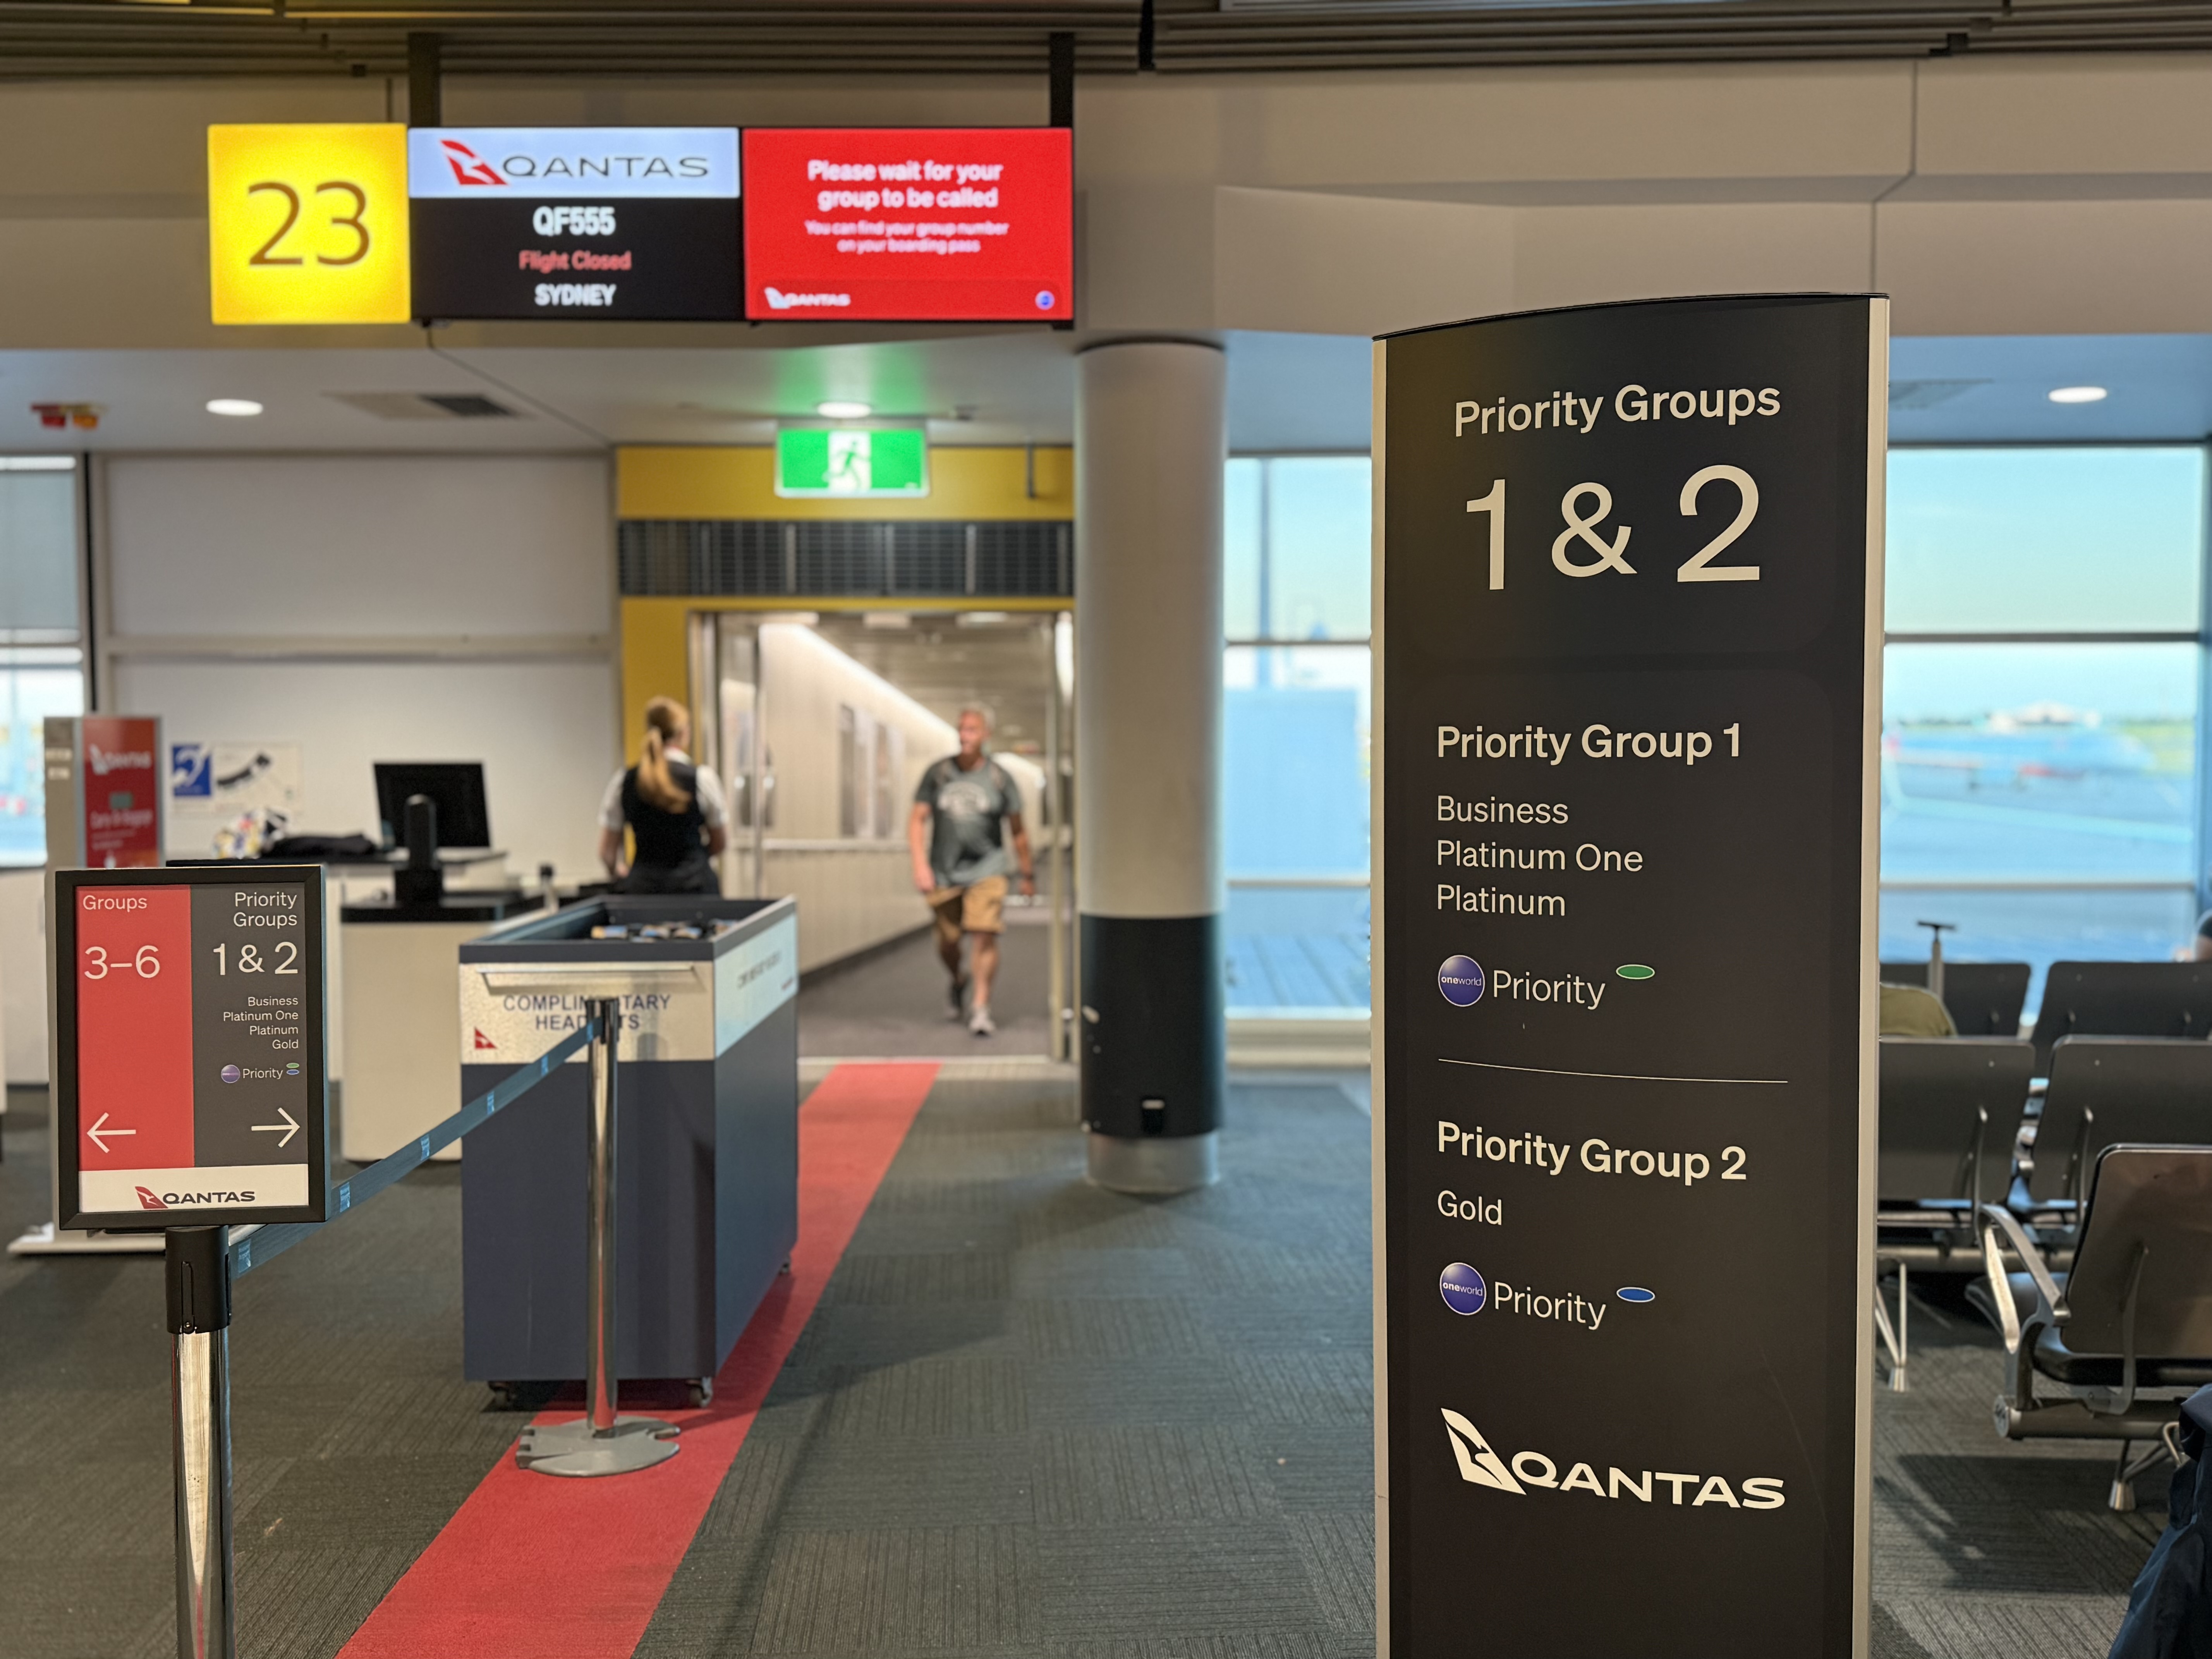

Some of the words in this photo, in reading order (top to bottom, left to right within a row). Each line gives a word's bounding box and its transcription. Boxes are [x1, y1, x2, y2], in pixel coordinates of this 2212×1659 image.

[502, 155, 709, 177] QANTAS
[807, 160, 877, 181] Please
[878, 160, 922, 181] wait
[922, 160, 955, 181] for
[956, 164, 1004, 185] your
[817, 191, 880, 212] group
[881, 188, 905, 208] to
[906, 187, 935, 208] be
[936, 187, 999, 208] called
[248, 180, 370, 266] 23
[533, 206, 616, 236] QF555
[519, 250, 569, 274] Flight
[571, 250, 632, 270] Closed
[535, 283, 617, 306] SYDNEY
[1456, 391, 1604, 437] Priority
[1615, 384, 1780, 426] Groups
[1467, 479, 1505, 590] 1
[1551, 482, 1638, 577] &
[1677, 465, 1760, 582] 2
[1438, 725, 1572, 766] Priority
[1582, 724, 1712, 765] Group
[1723, 723, 1739, 757] 1
[1438, 795, 1568, 824] Business
[1438, 840, 1565, 870] Platinum
[1576, 843, 1643, 872] One
[83, 895, 147, 913] Groups
[235, 891, 297, 909] Priority
[1438, 884, 1565, 916] Platinum
[233, 912, 297, 929] Groups
[213, 943, 225, 975] 1
[239, 945, 265, 973] &
[275, 941, 298, 974] 2
[248, 996, 298, 1006] Business
[503, 994, 671, 1011] COMPLITARY
[1441, 977, 1482, 986] oneworld
[1494, 970, 1606, 1010] Priority
[223, 1011, 272, 1022] Platinum
[275, 1010, 299, 1020] One
[250, 1025, 298, 1035] Platinum
[272, 1039, 299, 1049] Gold
[243, 1067, 283, 1080] Priority
[1438, 1121, 1570, 1175] Priority
[1580, 1139, 1710, 1186] Group
[1721, 1146, 1747, 1180] 2
[163, 1190, 256, 1204] QANTAS
[1437, 1190, 1502, 1225] Gold
[1443, 1282, 1482, 1296] oneworld
[1495, 1281, 1606, 1330] Priority
[1511, 1451, 1785, 1509] QANTAS
